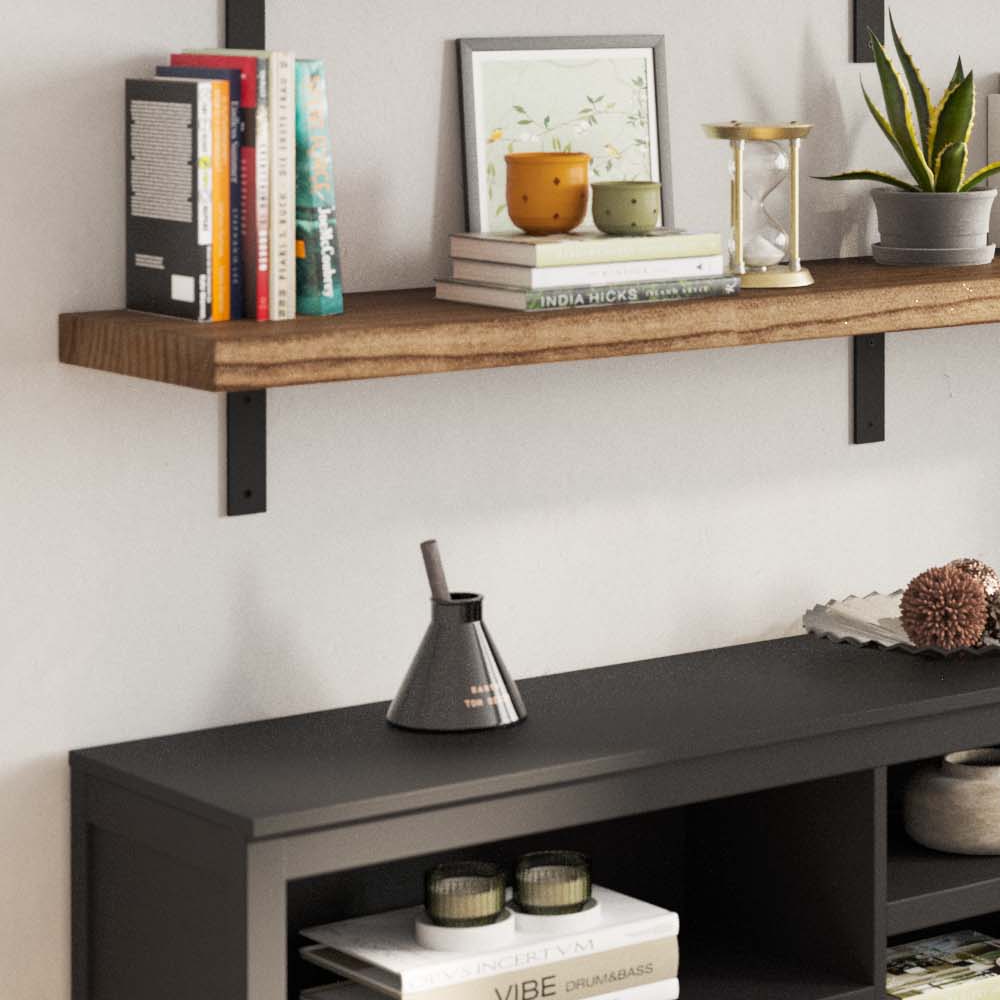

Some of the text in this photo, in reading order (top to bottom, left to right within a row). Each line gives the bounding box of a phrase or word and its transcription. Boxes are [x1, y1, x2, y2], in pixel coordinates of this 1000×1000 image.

[540, 293, 585, 309] INDIA
[589, 288, 639, 305] HICKS
[494, 963, 654, 1000] VIBE DRUM&BASS
